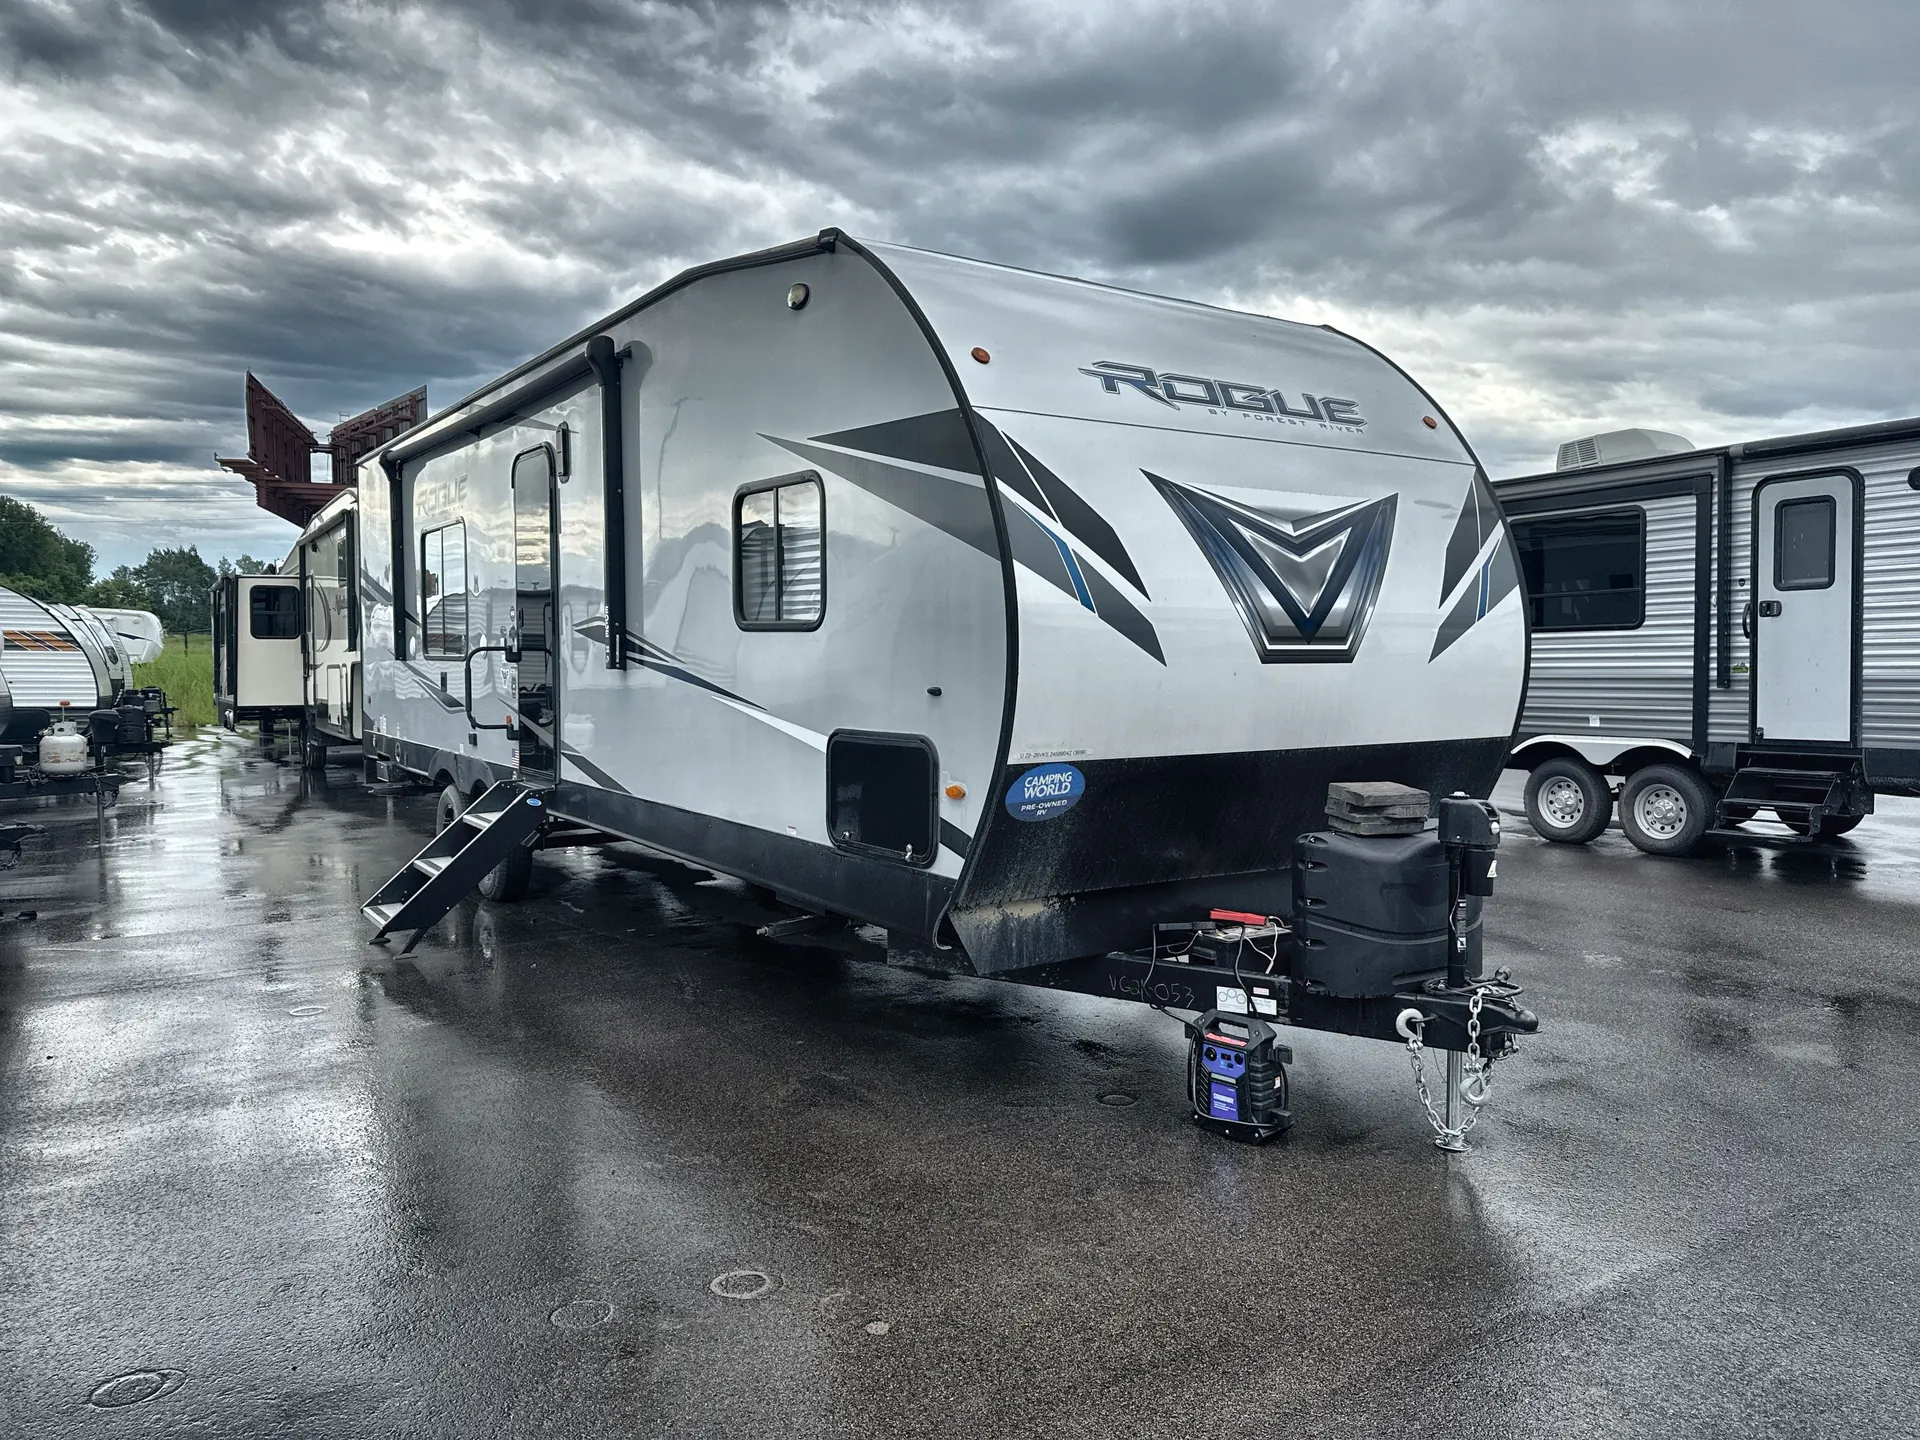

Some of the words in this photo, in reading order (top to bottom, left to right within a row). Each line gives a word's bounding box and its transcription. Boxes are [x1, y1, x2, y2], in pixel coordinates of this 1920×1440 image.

[1077, 360, 1368, 427] ROGUE
[1208, 408, 1227, 416] BY
[1242, 413, 1306, 426] FOREST
[1319, 423, 1364, 434] RIVER
[416, 474, 468, 517] ROGUE
[1024, 772, 1072, 788] CAMPING
[1024, 782, 1071, 799] WORLD
[1021, 800, 1067, 811] PRE-OWNED
